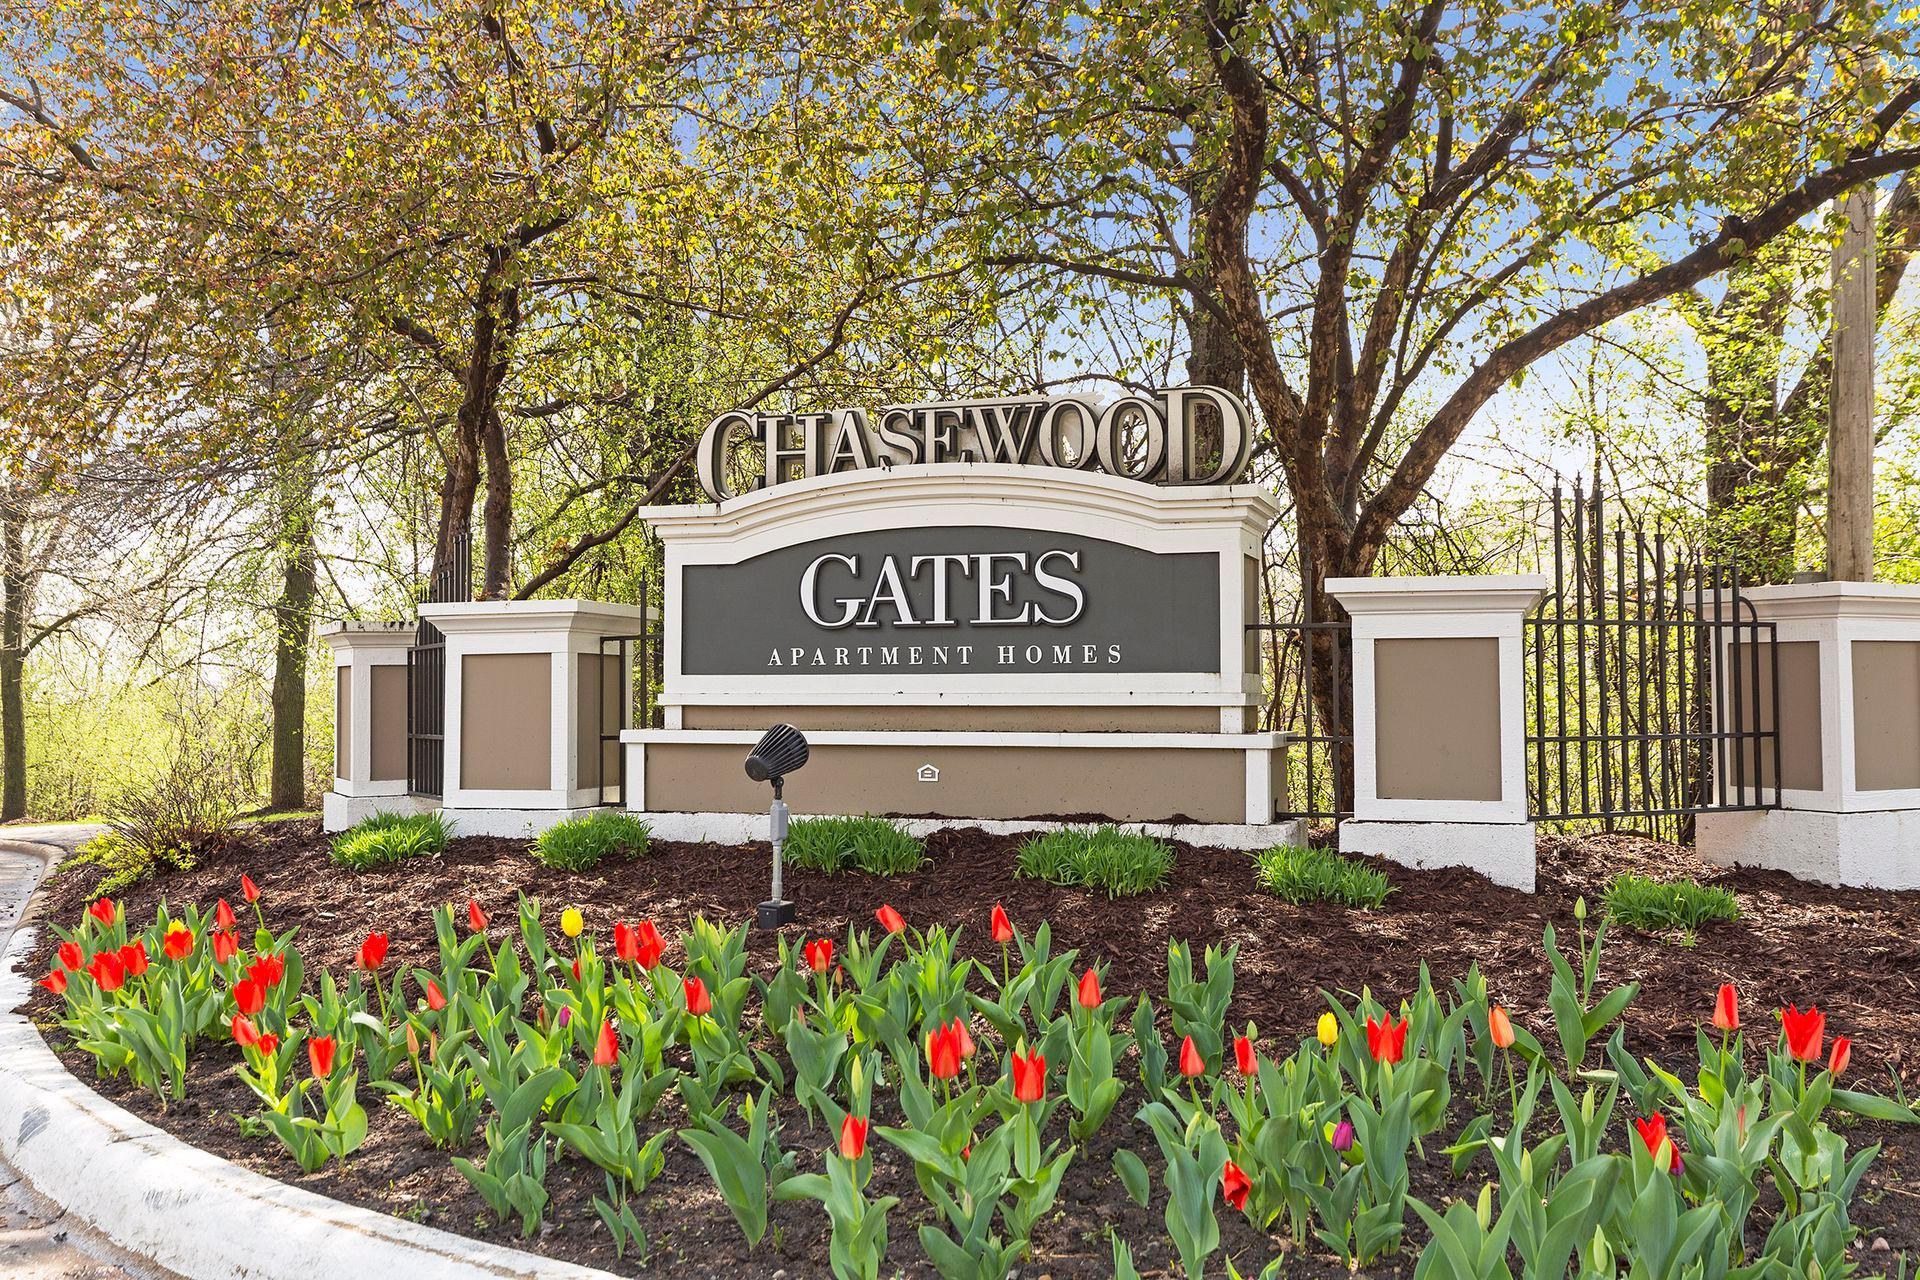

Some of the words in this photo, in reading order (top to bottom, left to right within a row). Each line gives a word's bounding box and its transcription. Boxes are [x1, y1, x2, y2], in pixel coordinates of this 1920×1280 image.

[697, 385, 1253, 501] CHASEWOOD
[799, 549, 1087, 628] GATES
[767, 645, 974, 666] APARTMENT
[997, 644, 1122, 665] HOMES
